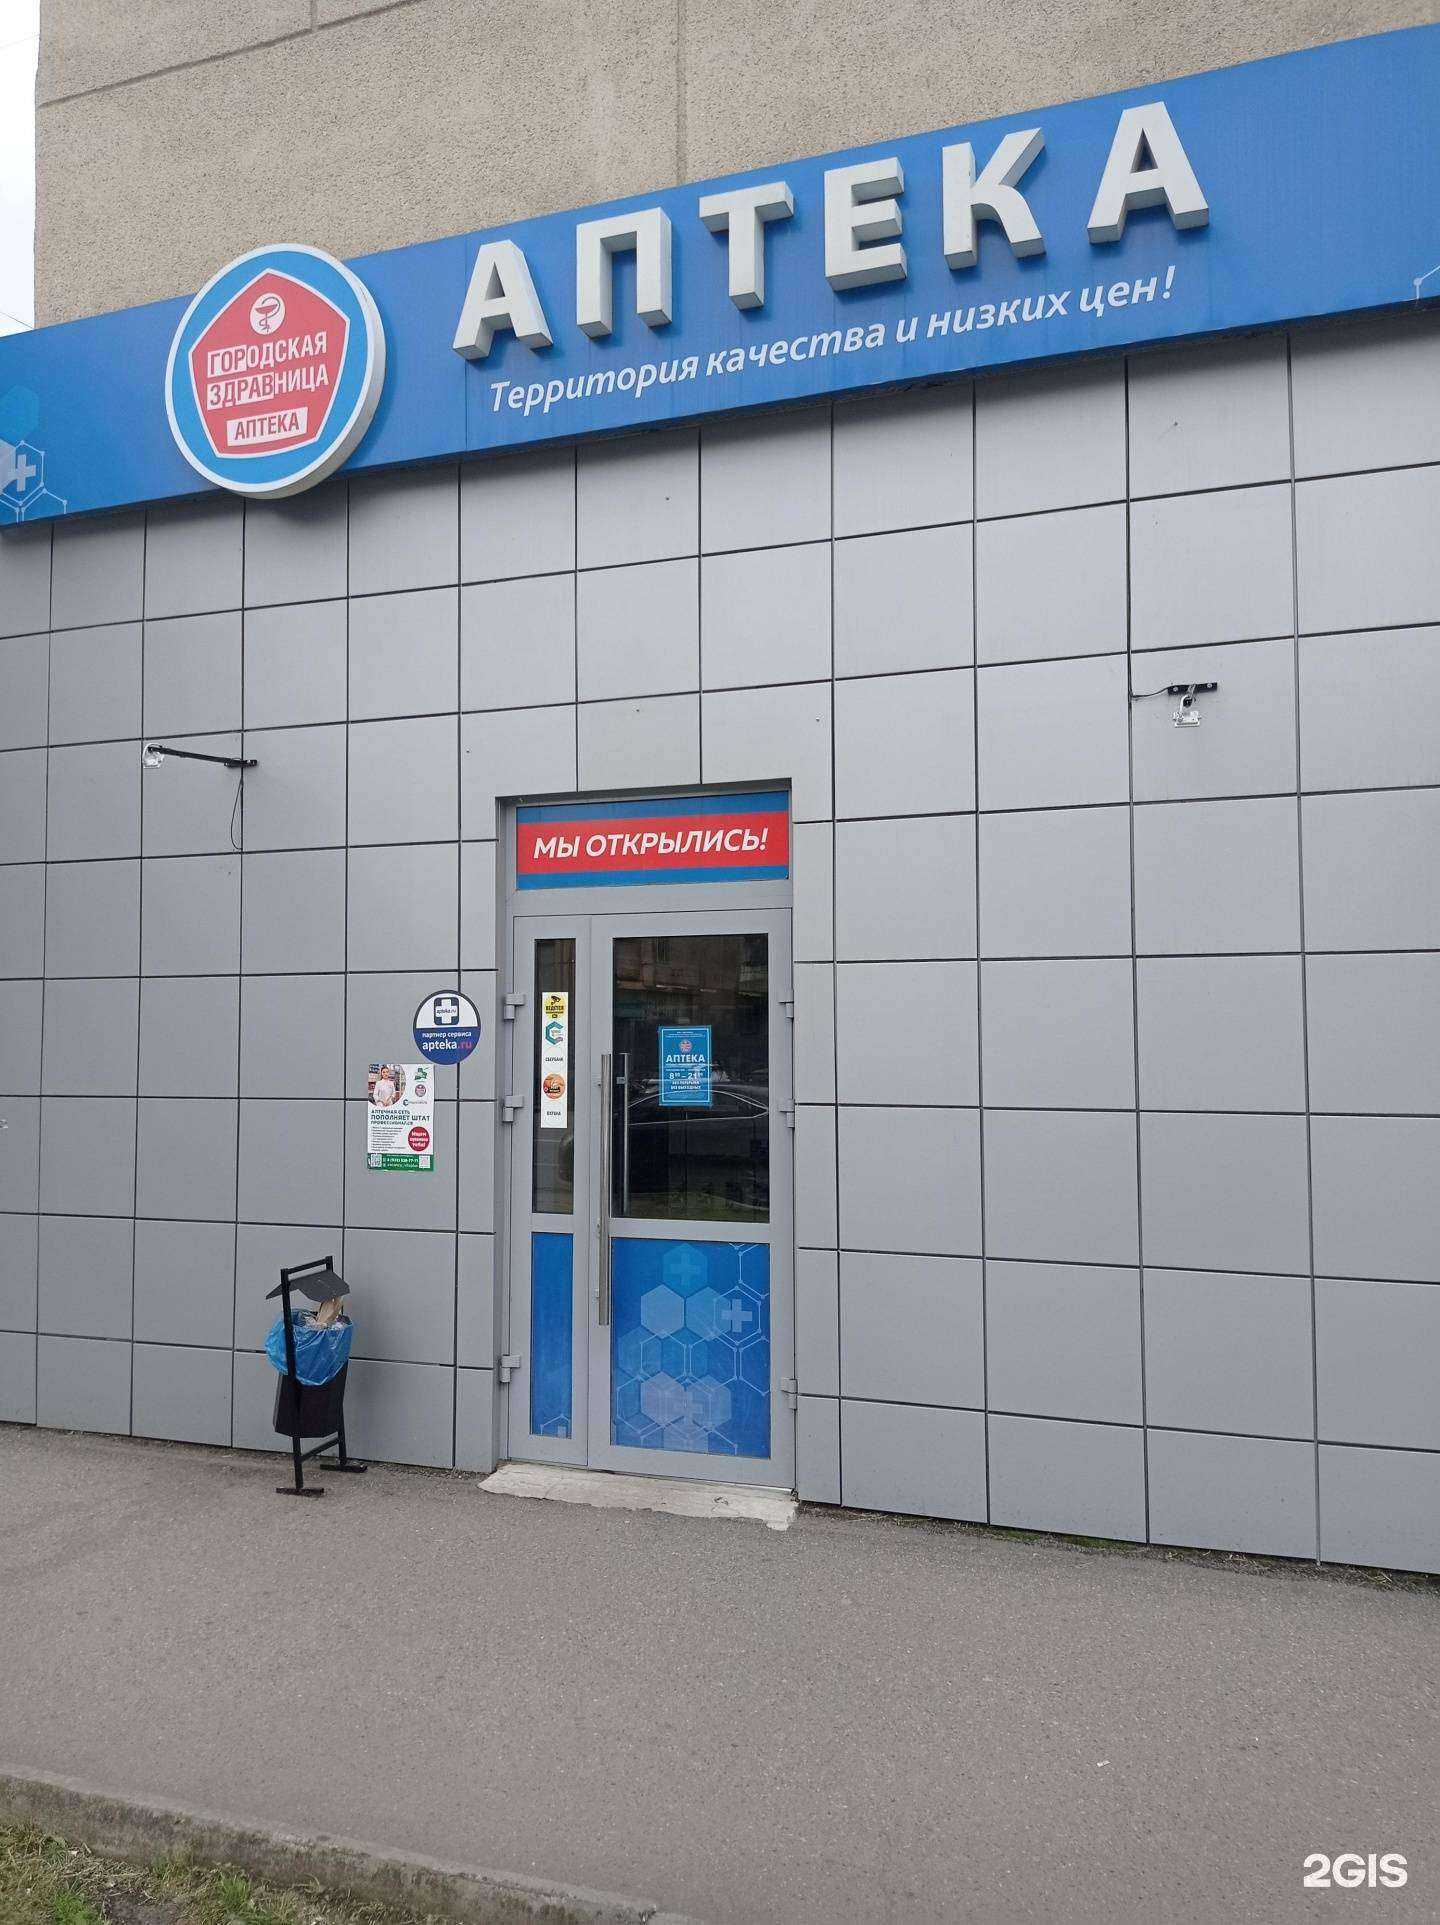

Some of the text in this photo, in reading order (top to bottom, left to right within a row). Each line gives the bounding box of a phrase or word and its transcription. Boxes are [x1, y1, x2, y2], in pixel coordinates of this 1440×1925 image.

[453, 101, 1209, 361] АПТЕКА
[208, 331, 328, 374] ГОРОДСКАЯ
[490, 265, 1176, 417] Территория качества и низких цен!
[208, 364, 329, 408] ЗДРАВНИЦА
[234, 412, 300, 441] АПТЕКА
[533, 828, 769, 859] МЫ ОТКРЫЛИСЬ!
[422, 1039, 473, 1051] apteka.ru
[665, 1054, 706, 1063] АПТЕКА
